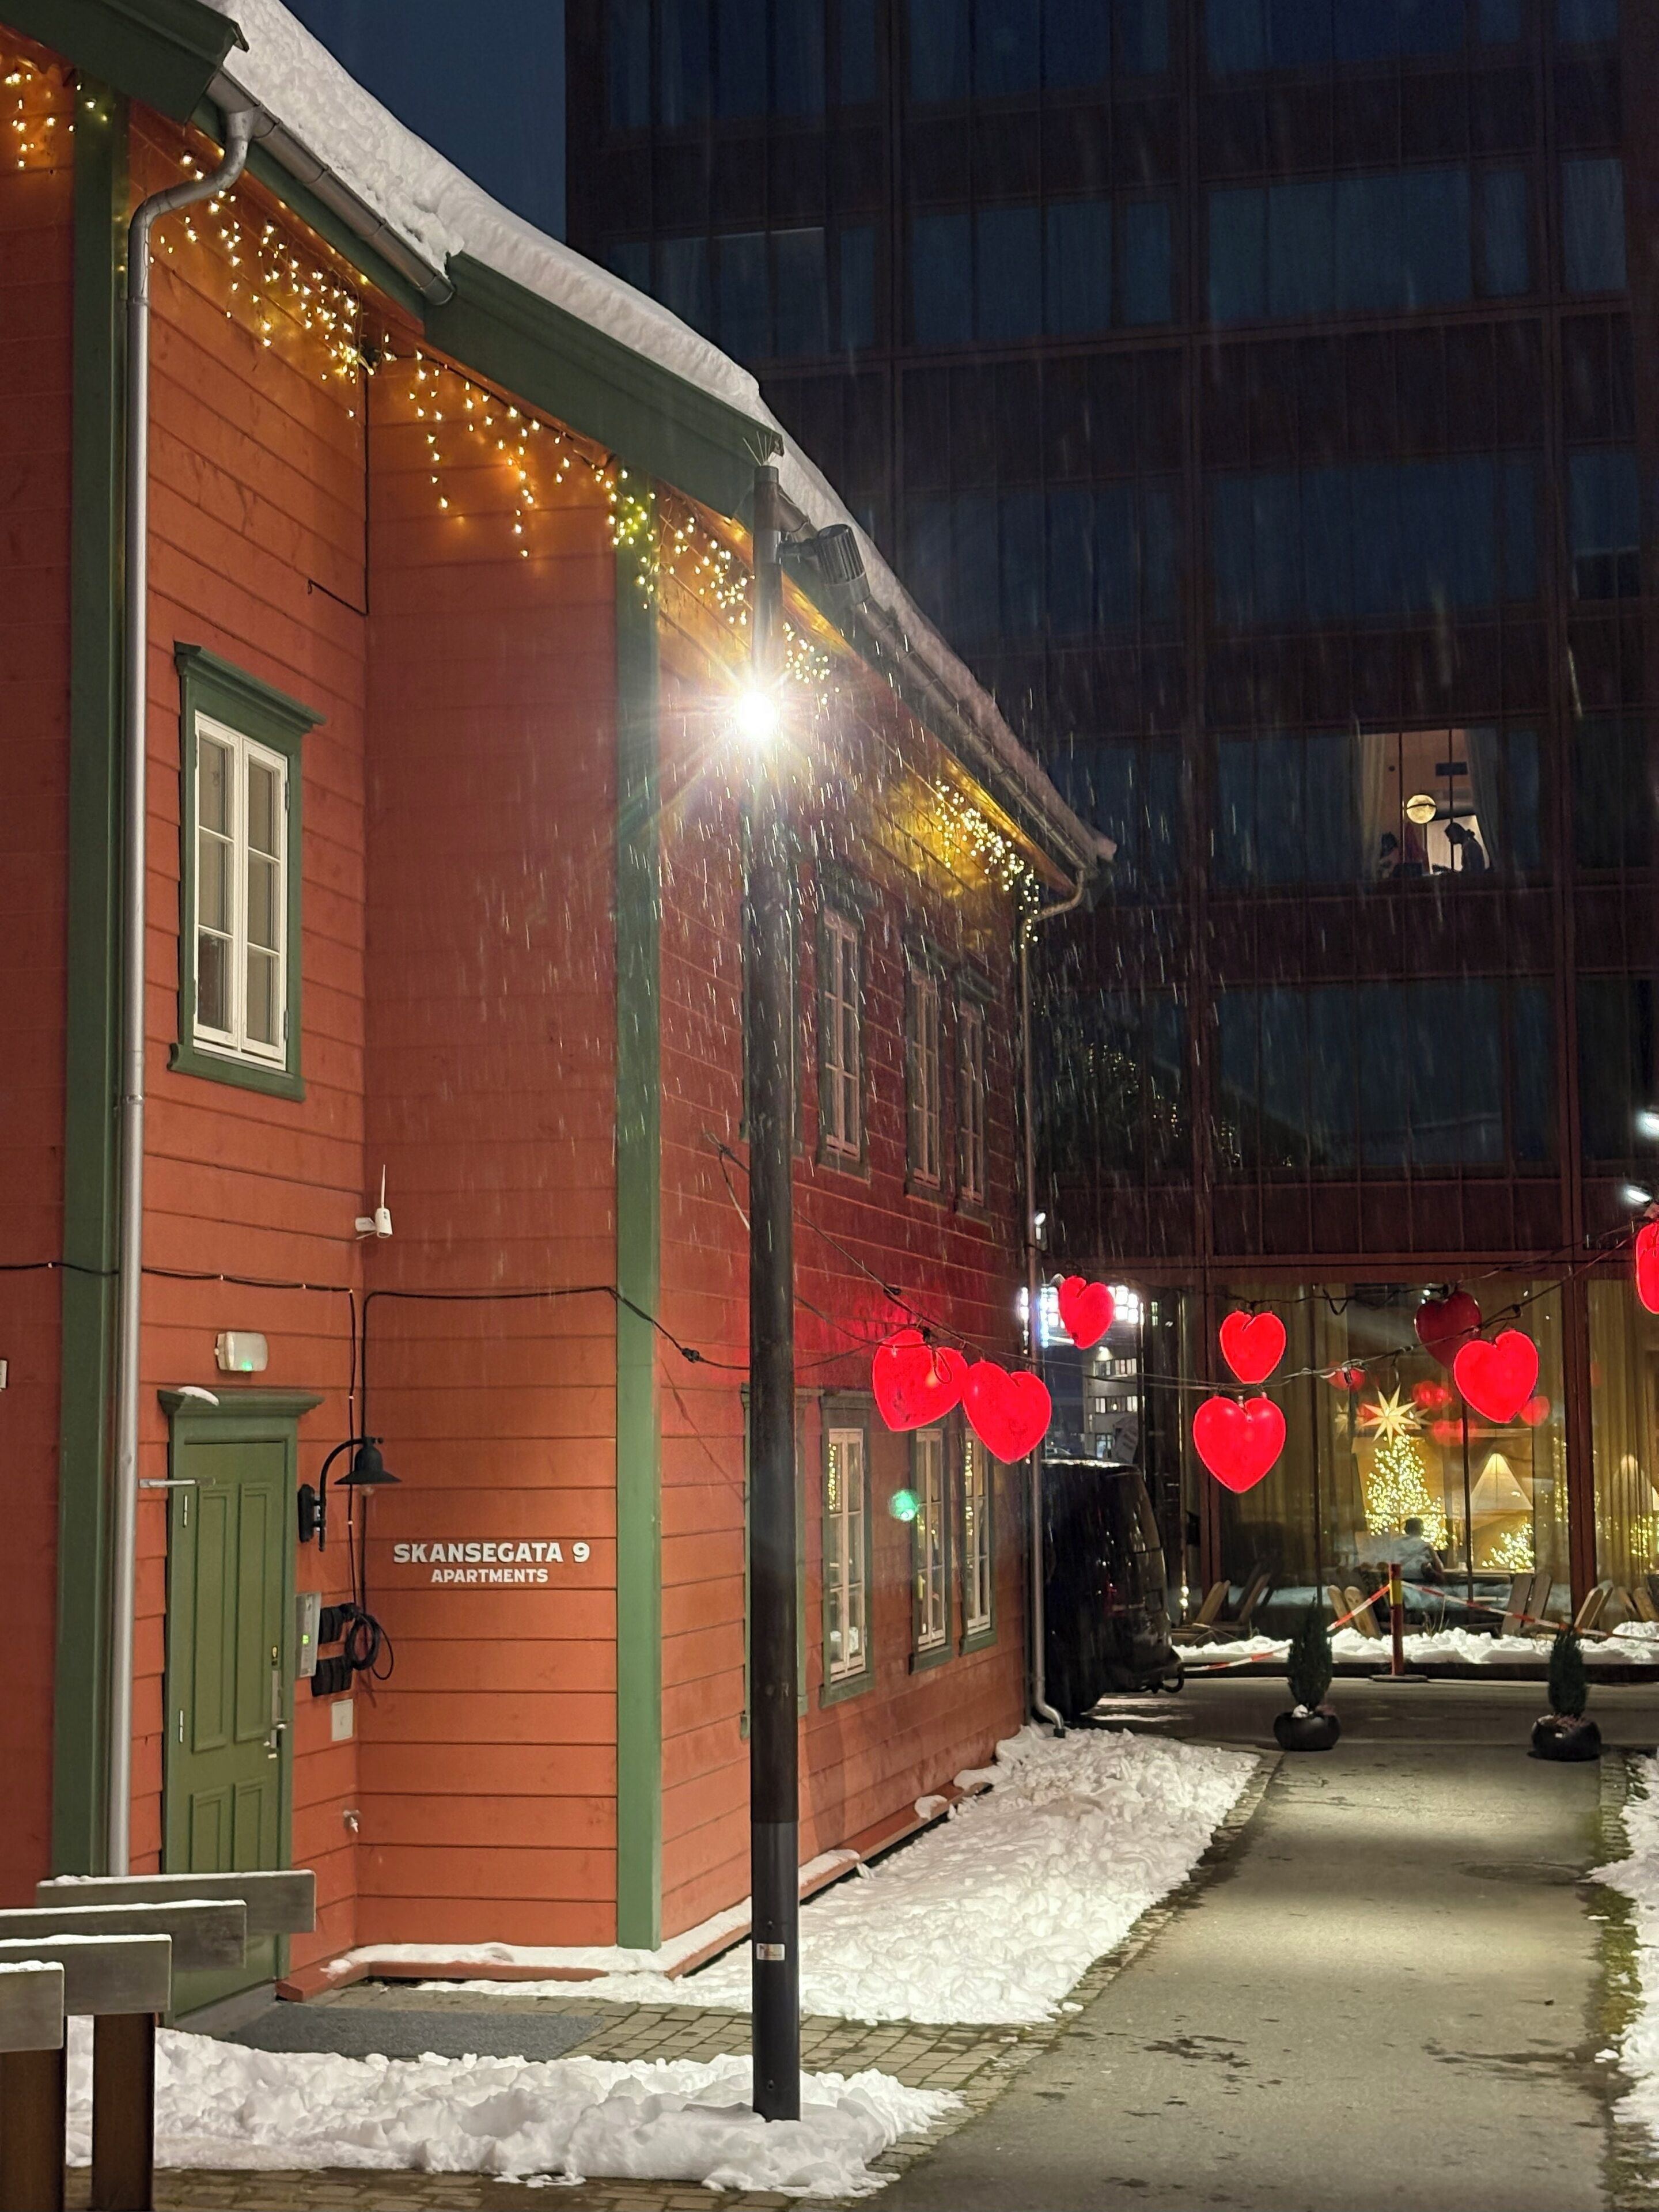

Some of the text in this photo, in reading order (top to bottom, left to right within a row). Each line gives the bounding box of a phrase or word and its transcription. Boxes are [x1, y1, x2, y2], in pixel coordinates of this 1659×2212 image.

[393, 1541, 590, 1563] SKANSEGATA 9
[431, 1568, 548, 1583] APARTMENTS
